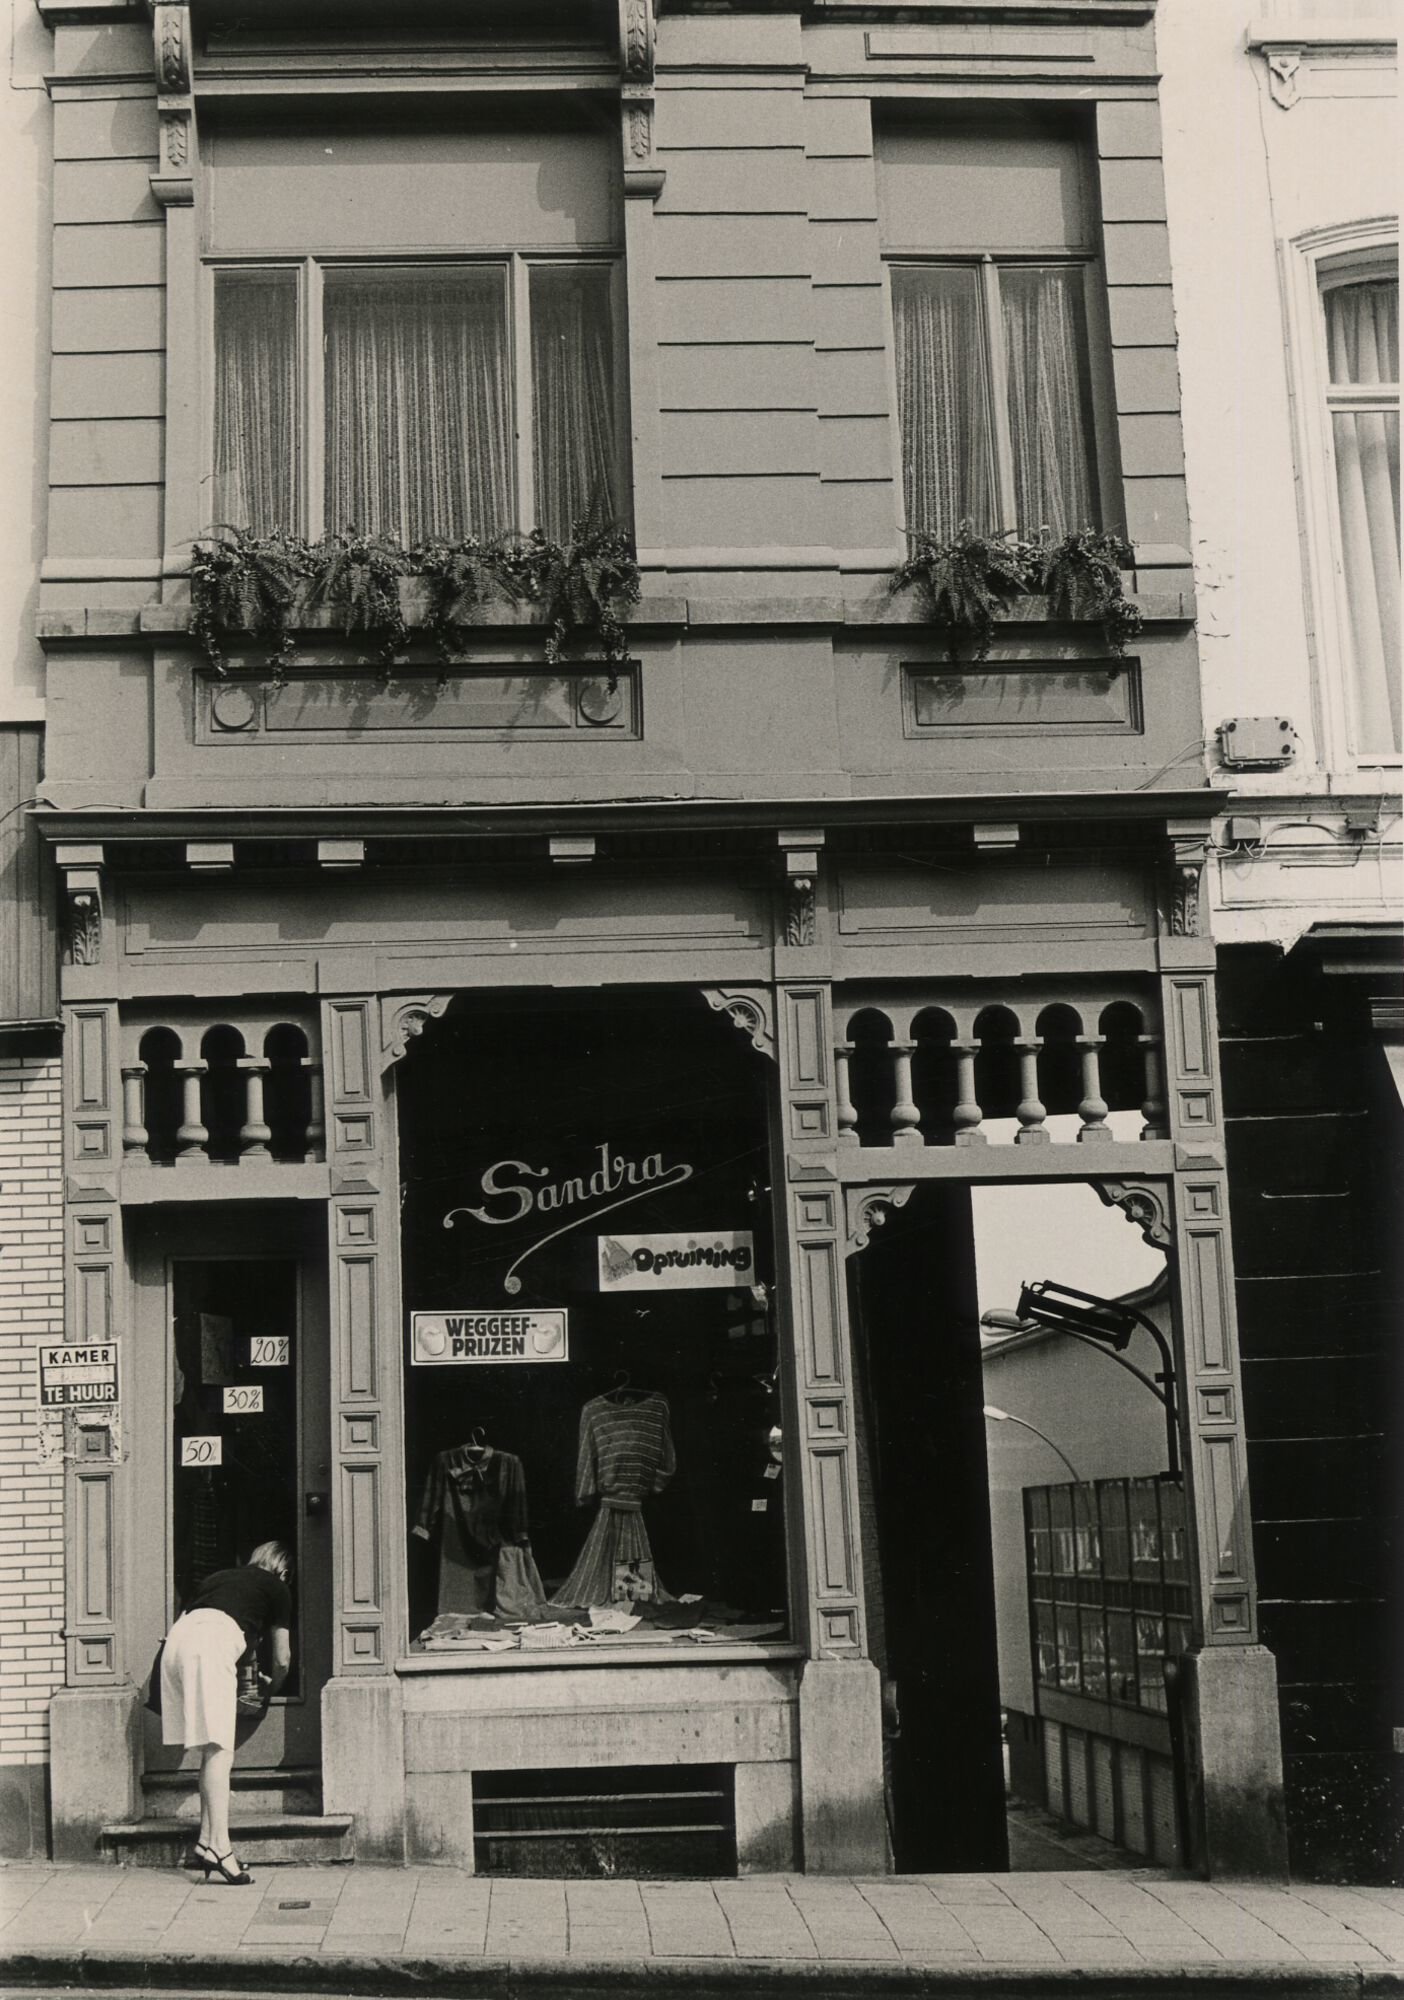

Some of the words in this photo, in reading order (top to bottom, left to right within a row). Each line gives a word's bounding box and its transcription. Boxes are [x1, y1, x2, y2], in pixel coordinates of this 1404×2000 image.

[443, 1143, 693, 1229] Sandra
[445, 1317, 538, 1338] WEGGEEF-
[49, 1349, 109, 1364] KAMER
[252, 1338, 289, 1364] 20%
[452, 1337, 525, 1357] PRIJZEN
[44, 1386, 64, 1403] TE
[69, 1384, 115, 1402] HUUR
[226, 1388, 260, 1410] 30%
[184, 1440, 217, 1463] 50%
